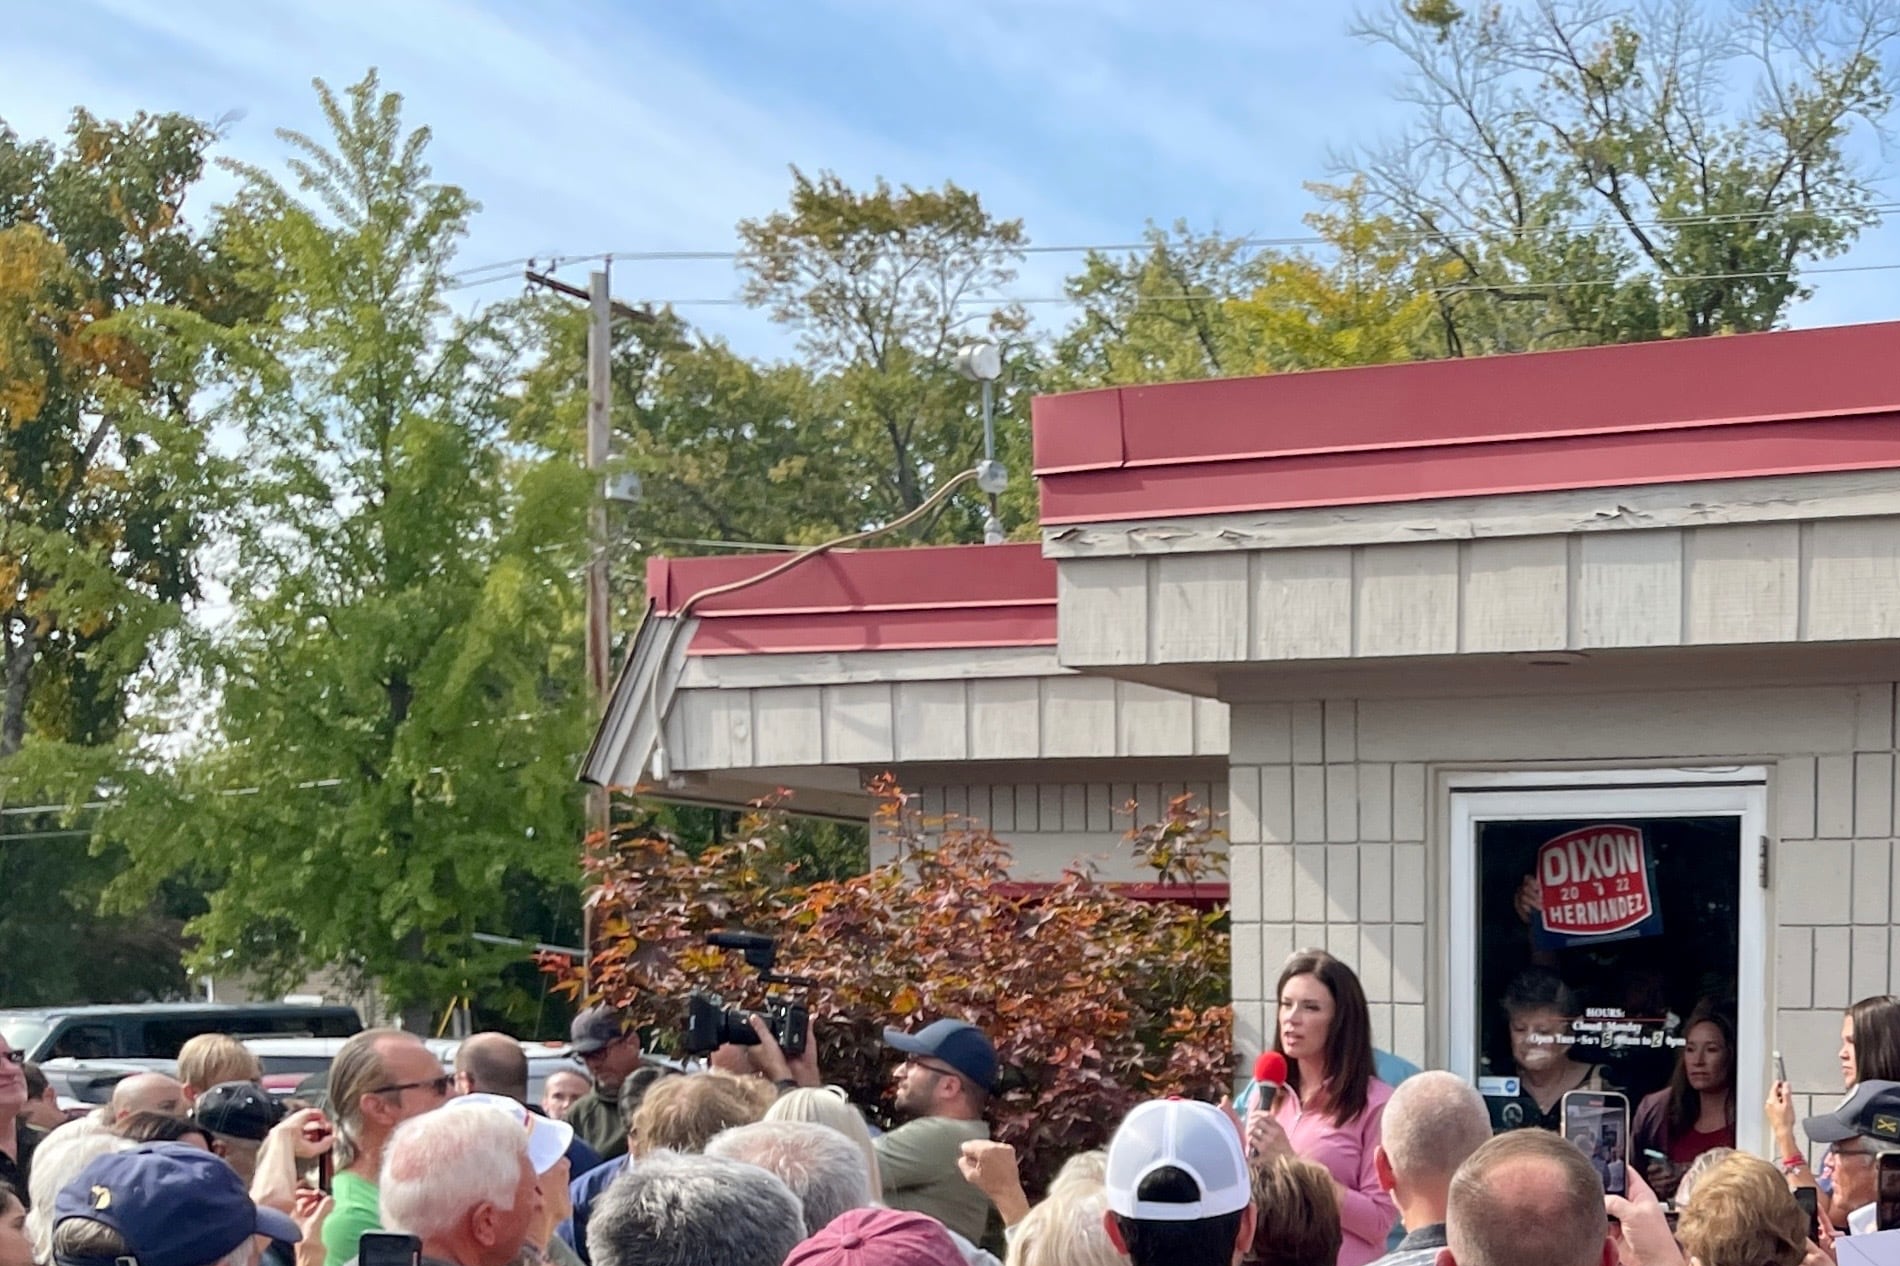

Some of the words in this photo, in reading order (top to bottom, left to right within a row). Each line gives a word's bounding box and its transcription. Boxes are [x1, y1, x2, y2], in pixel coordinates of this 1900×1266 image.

[1543, 834, 1639, 887] DIXON
[1560, 886, 1579, 900] 20
[1616, 878, 1630, 891] 22
[1549, 893, 1645, 925] HERNANDEZ
